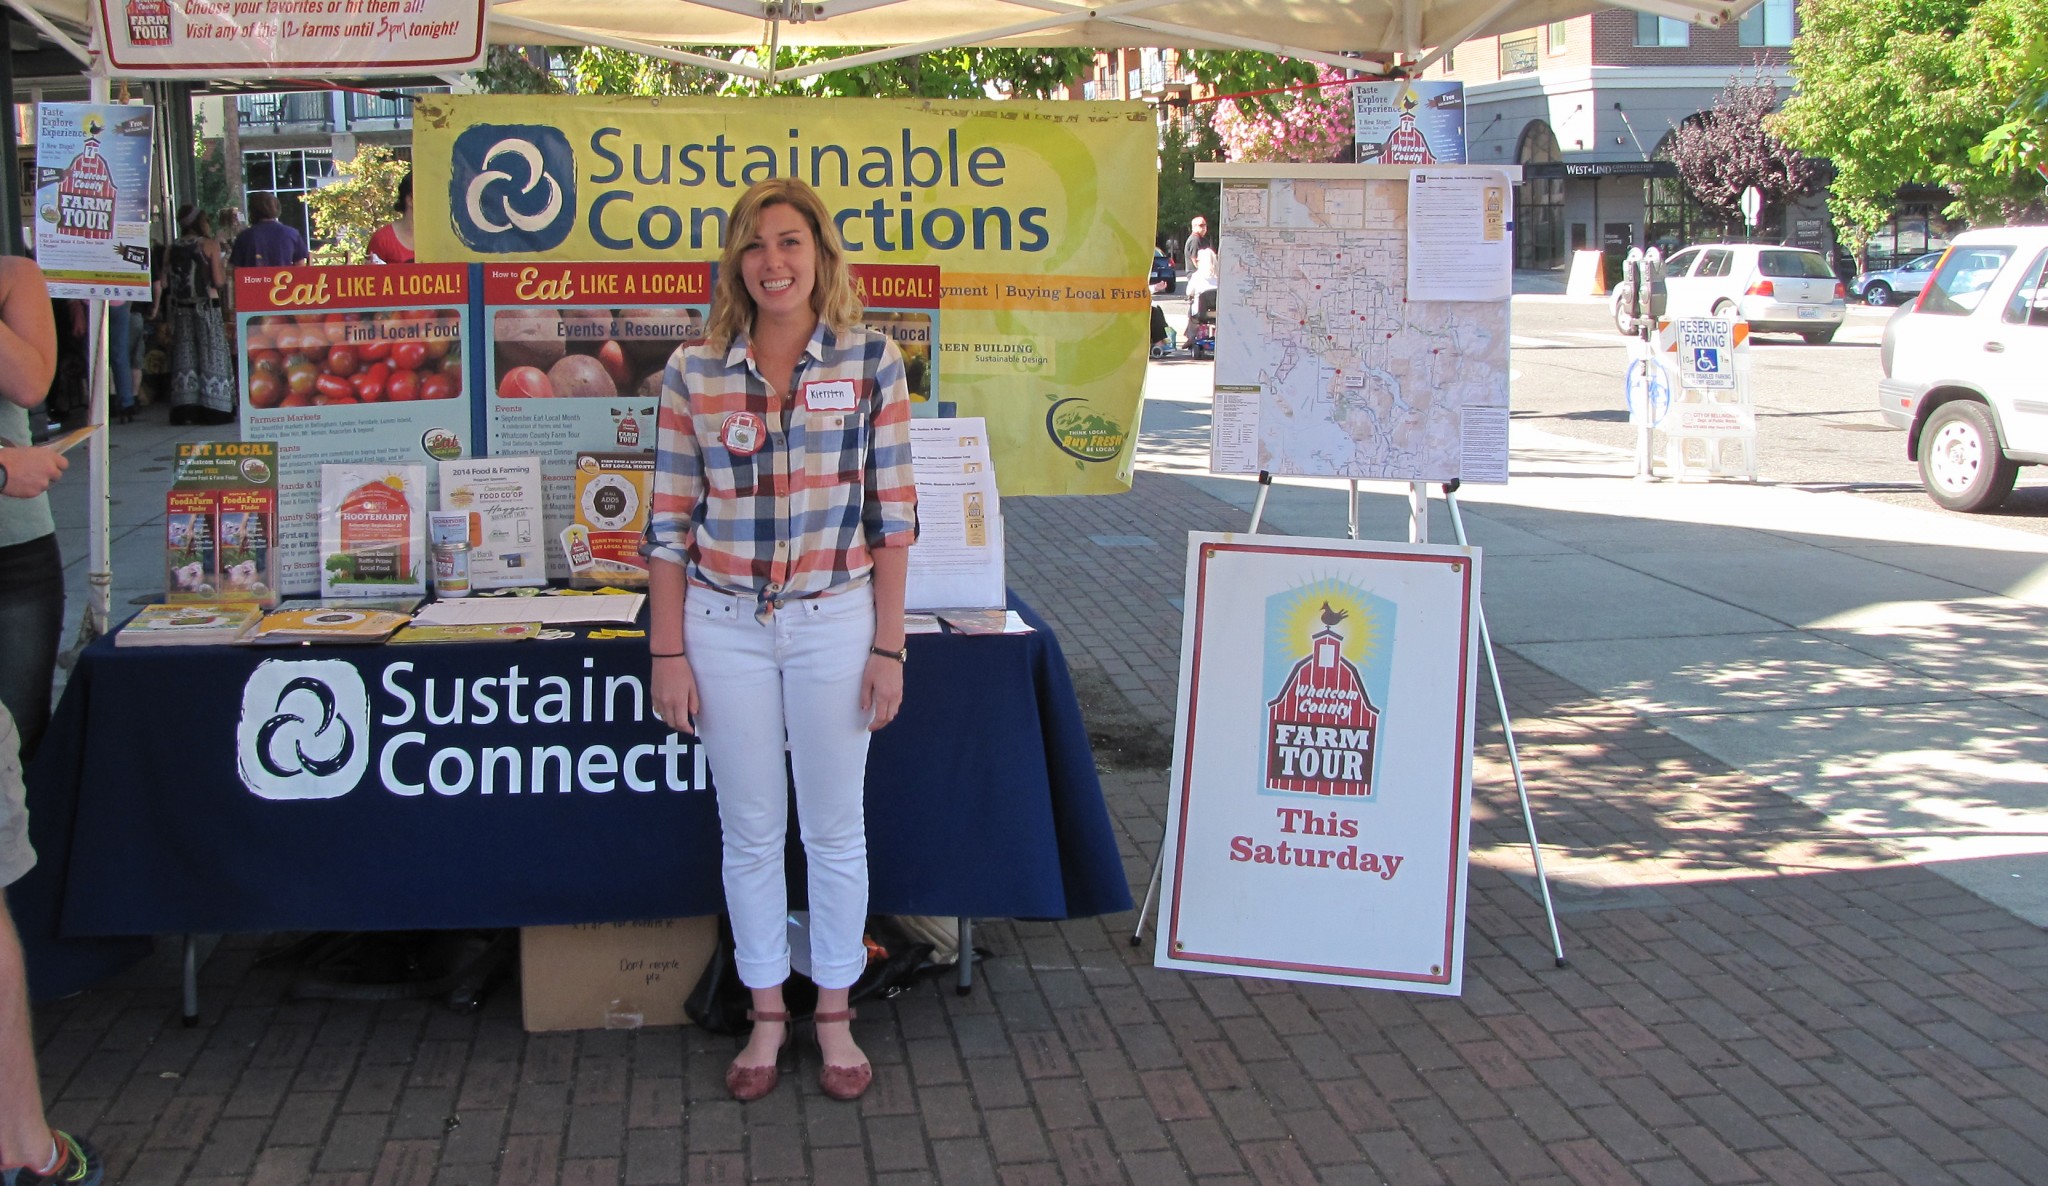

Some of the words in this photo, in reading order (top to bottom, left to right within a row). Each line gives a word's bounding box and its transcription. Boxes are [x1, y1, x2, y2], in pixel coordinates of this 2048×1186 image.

[185, 0, 230, 14] Choose
[234, 2, 261, 17] your
[264, 0, 323, 13] favorites
[327, 1, 342, 13] or
[345, 0, 363, 13] hit
[367, 0, 400, 13] them
[403, 0, 426, 13] all!
[130, 15, 169, 26] FARM
[132, 25, 168, 40] TOUR
[186, 22, 212, 38] Visit
[216, 25, 237, 41] any
[241, 22, 254, 38] of
[255, 21, 277, 38] the
[282, 20, 299, 38] 12
[302, 22, 340, 37] farms
[344, 21, 375, 36] until
[377, 16, 408, 42] 5pm
[409, 20, 460, 39] tonight!
[1356, 86, 1378, 94] Taste
[1357, 95, 1388, 105] Explore
[42, 107, 64, 116] Taste
[42, 118, 74, 129] Explore
[129, 120, 143, 128] Free
[42, 128, 87, 139] Experience
[589, 121, 1006, 188] Sustainable
[1391, 144, 1426, 154] Whatcom
[1394, 152, 1422, 164] County
[72, 170, 108, 182] Whatcom
[74, 179, 103, 191] County
[61, 195, 112, 212] FARM
[63, 208, 110, 230] TOUR
[588, 190, 1050, 252] Conctions
[127, 251, 145, 263] Fun!
[244, 276, 262, 284] How
[269, 271, 331, 306] Eat
[336, 277, 376, 298] LIKE
[382, 276, 394, 297] A
[399, 274, 461, 296] LOCAL!
[515, 266, 575, 301] Eat
[580, 275, 619, 294] LIKE
[625, 275, 636, 294] A
[642, 274, 703, 294] LOCAL!
[856, 277, 867, 297] A
[872, 277, 933, 298] LOCAL!
[1006, 285, 1061, 301] Buying
[1065, 286, 1105, 299] Local
[1110, 288, 1147, 299] First
[344, 325, 376, 341] Find
[381, 324, 420, 340] Local
[425, 321, 460, 338] Food
[557, 322, 605, 337] Events
[610, 322, 620, 337] &
[625, 322, 700, 337] Resources
[892, 325, 930, 341] Local
[1680, 321, 1728, 334] RESERVED
[938, 344, 969, 352] REEN
[974, 343, 1033, 353] BUILDING
[1684, 335, 1725, 348] PARKING
[975, 355, 1020, 363] Sustainable
[1022, 356, 1048, 365] Design
[250, 416, 285, 424] Farmers
[287, 413, 321, 422] Markets
[501, 414, 532, 422] September
[433, 434, 459, 448] Eat
[529, 432, 550, 440] County
[1062, 435, 1088, 450] Buy
[1090, 434, 1122, 447] FRESH
[180, 445, 212, 456] EAT
[216, 443, 272, 456] LOCAL
[472, 467, 490, 475] Food
[344, 513, 408, 521] HOOTENANNY
[382, 658, 662, 725] Sustain
[1294, 684, 1359, 702] Whatcom
[1298, 699, 1353, 720] County
[1275, 724, 1370, 750] FARM
[380, 725, 707, 796] Connecti
[1279, 746, 1363, 780] TOUR
[1277, 807, 1359, 838] This
[1229, 836, 1404, 881] Saturday
